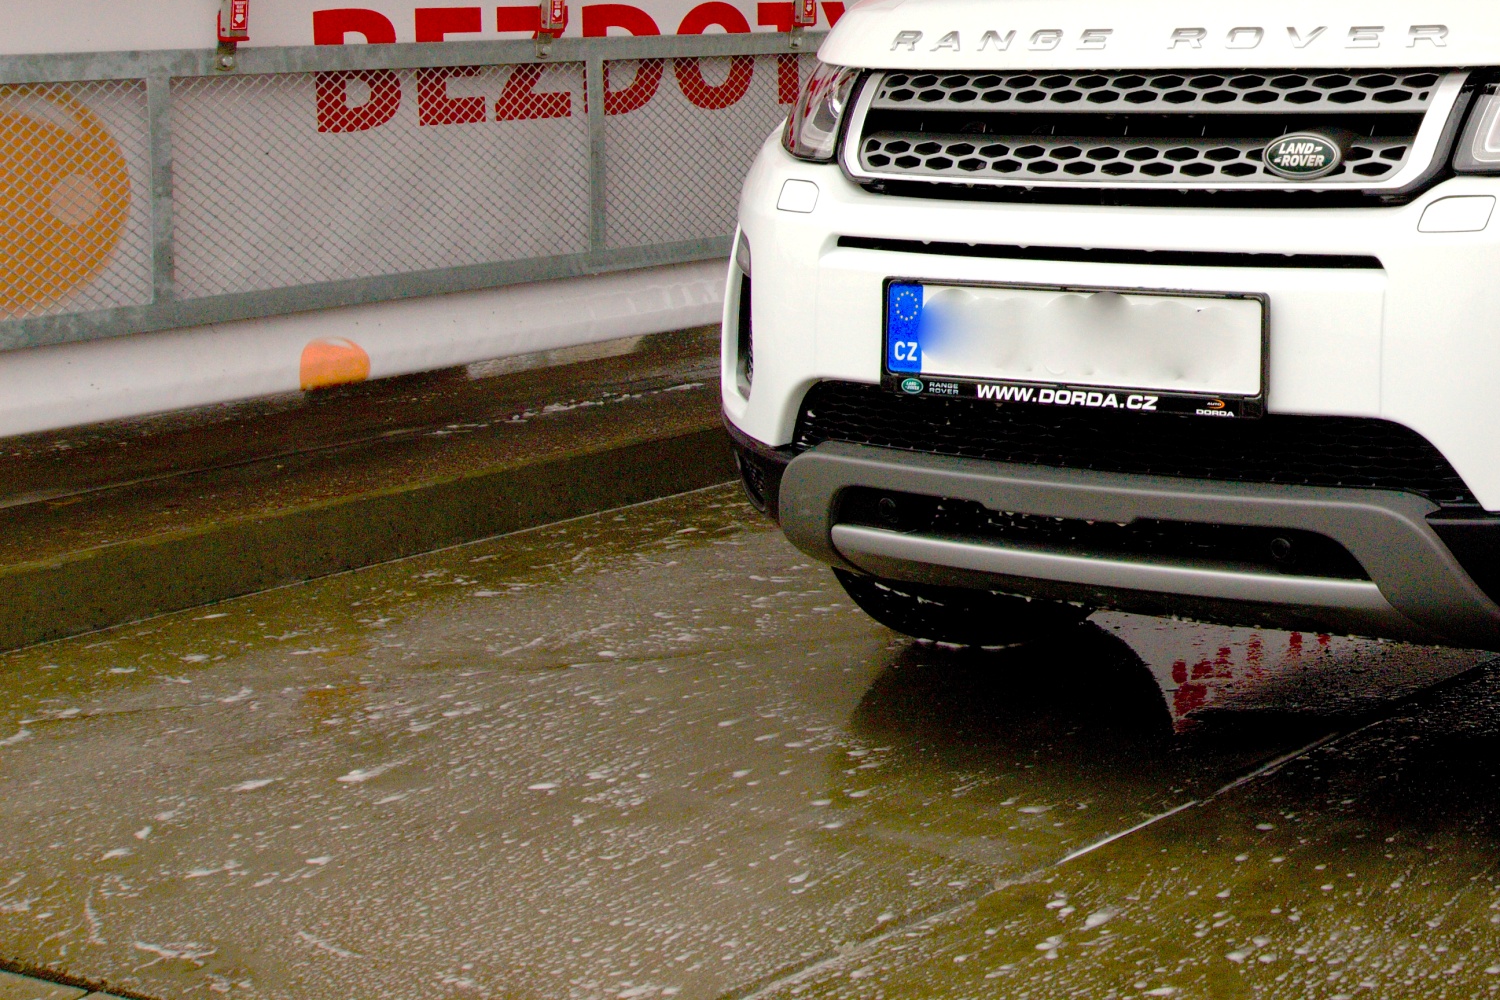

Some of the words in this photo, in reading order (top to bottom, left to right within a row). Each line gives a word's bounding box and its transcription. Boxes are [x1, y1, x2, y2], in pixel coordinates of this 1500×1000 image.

[890, 28, 1114, 51] RANGE
[1166, 23, 1450, 49] ROVER
[313, 0, 847, 133] BEZDOT
[1278, 142, 1315, 155] LAND
[1280, 154, 1325, 167] ROVER
[894, 341, 918, 361] CZ
[929, 381, 959, 389] RANGE
[929, 387, 959, 395] ROVER
[976, 383, 1159, 411] WWW.DORDA.CZ
[1195, 408, 1235, 417] DORDA
